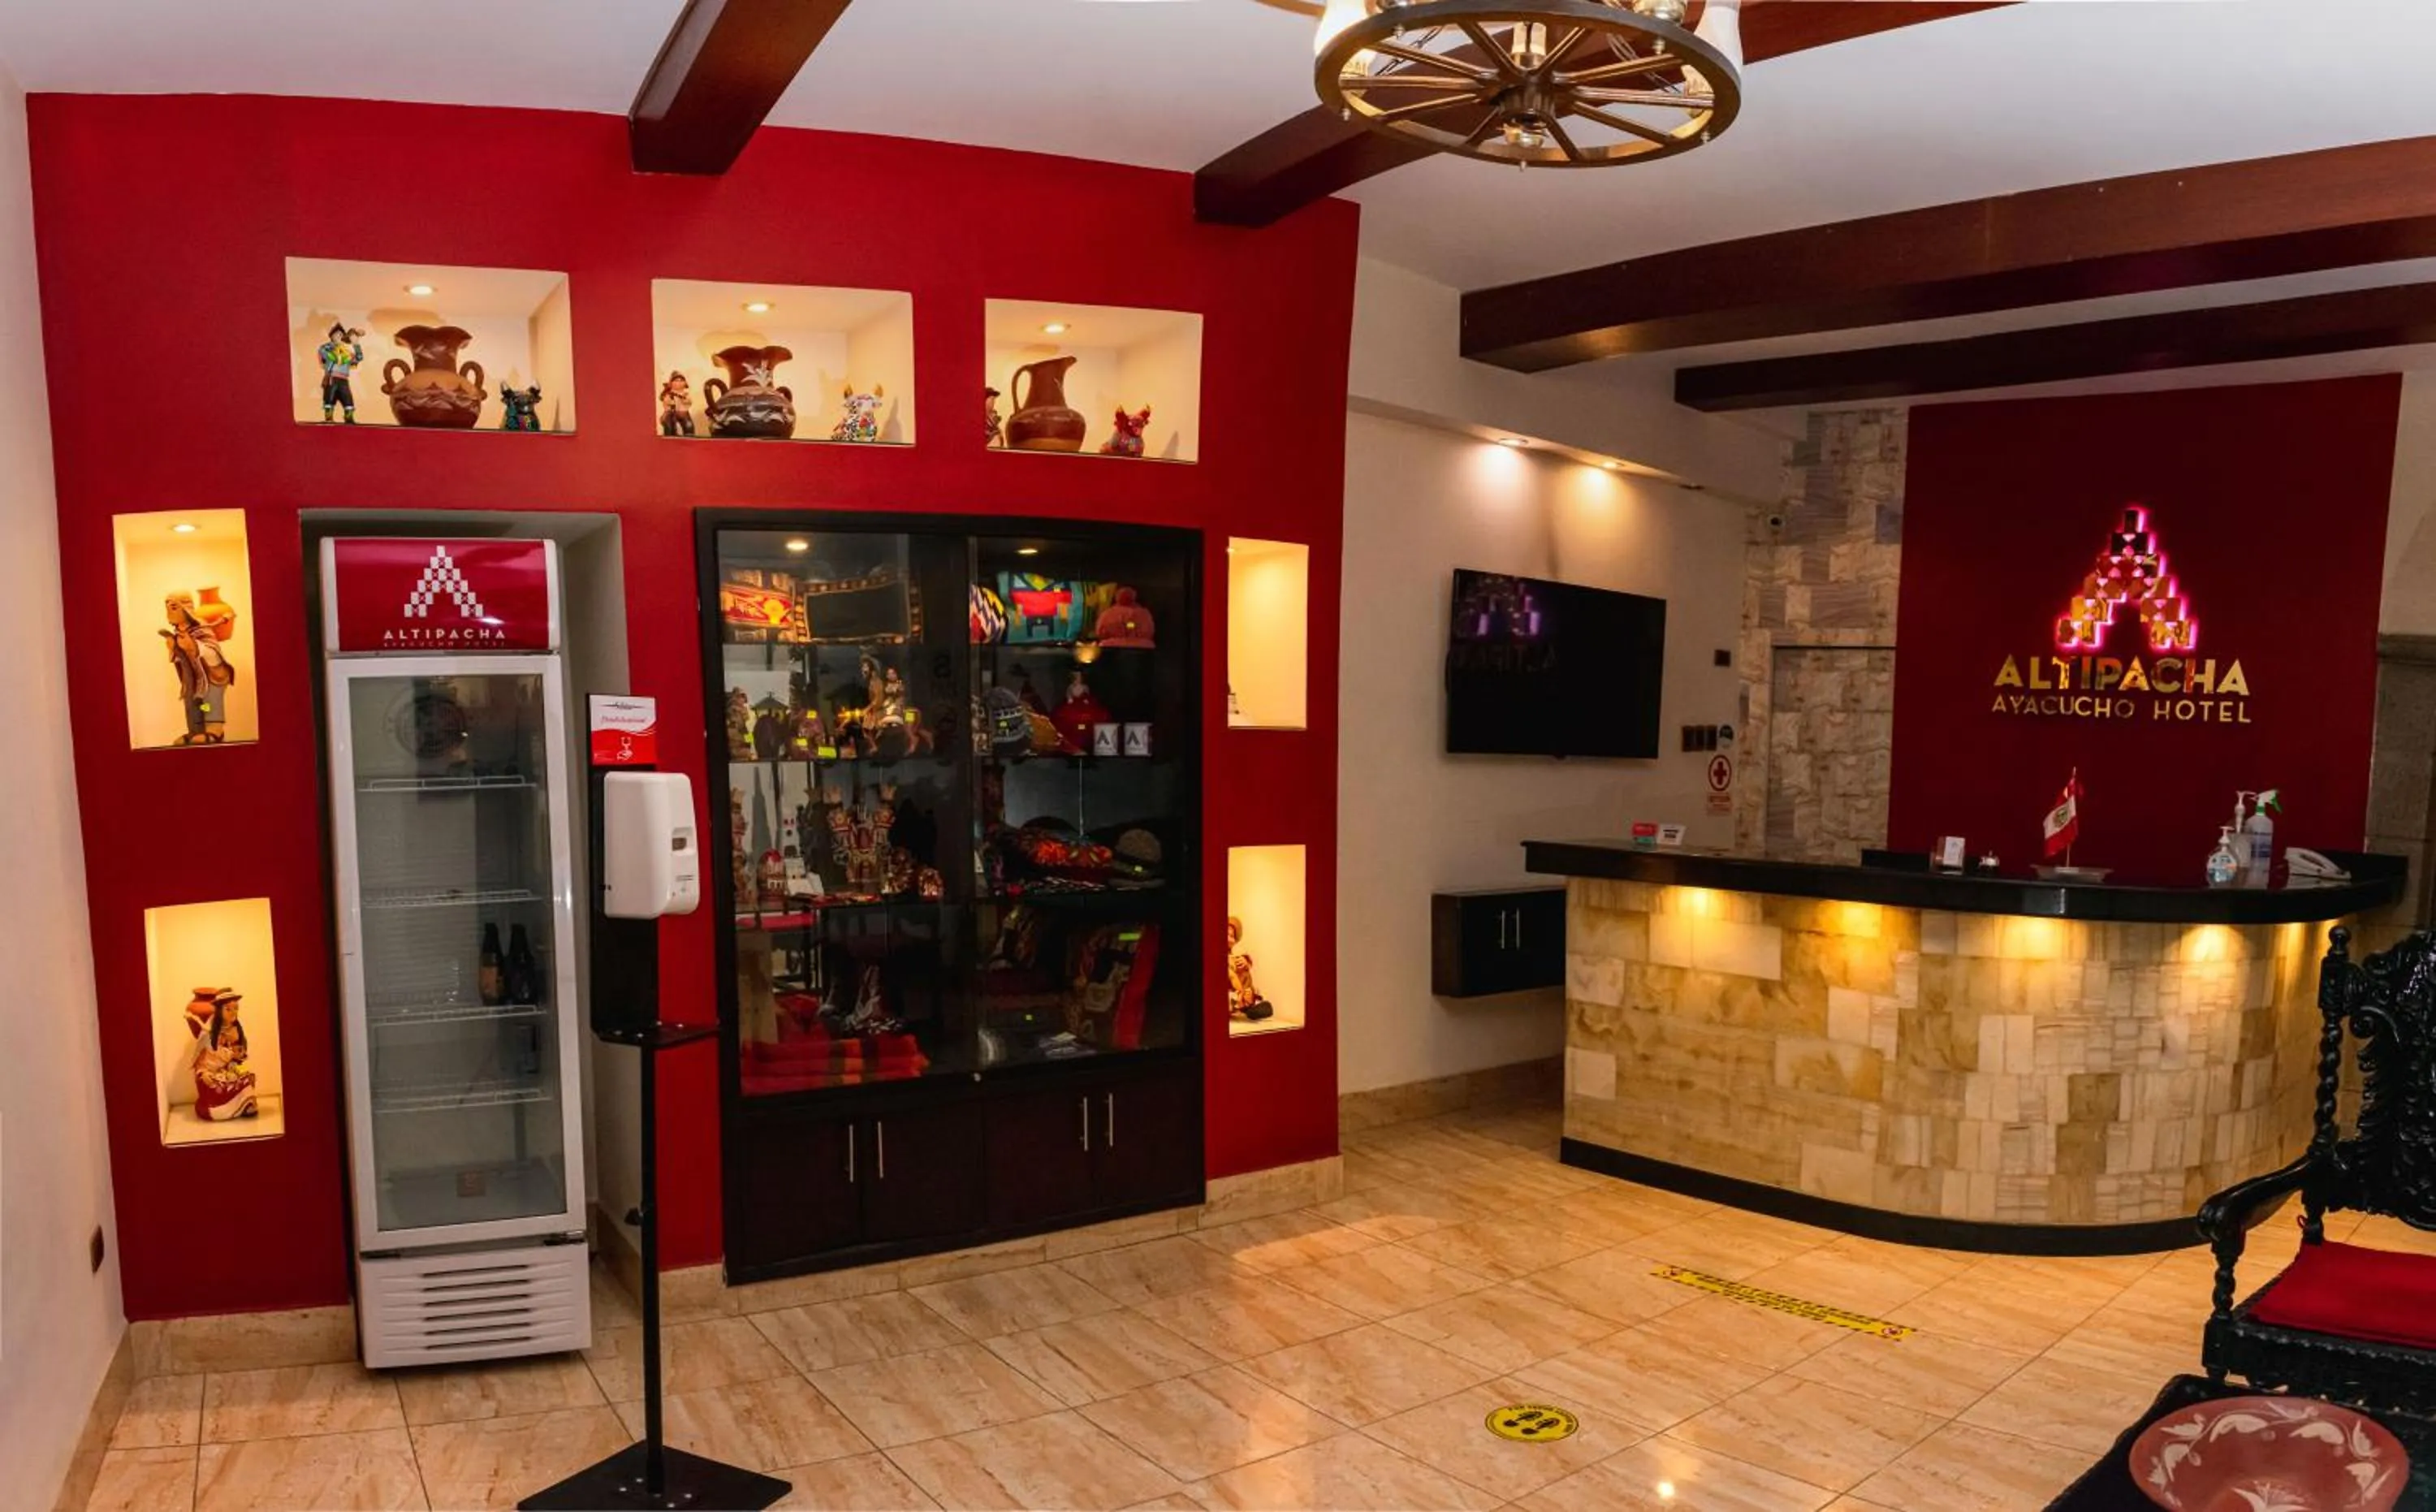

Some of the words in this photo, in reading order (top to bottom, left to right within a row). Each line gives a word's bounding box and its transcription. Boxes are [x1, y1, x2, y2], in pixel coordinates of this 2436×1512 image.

[383, 628, 505, 640] ALTIPACHA
[1993, 653, 2251, 696] ALTIPACHA
[1992, 694, 2136, 719] AYACUCHO
[2153, 699, 2252, 724] HOTEL
